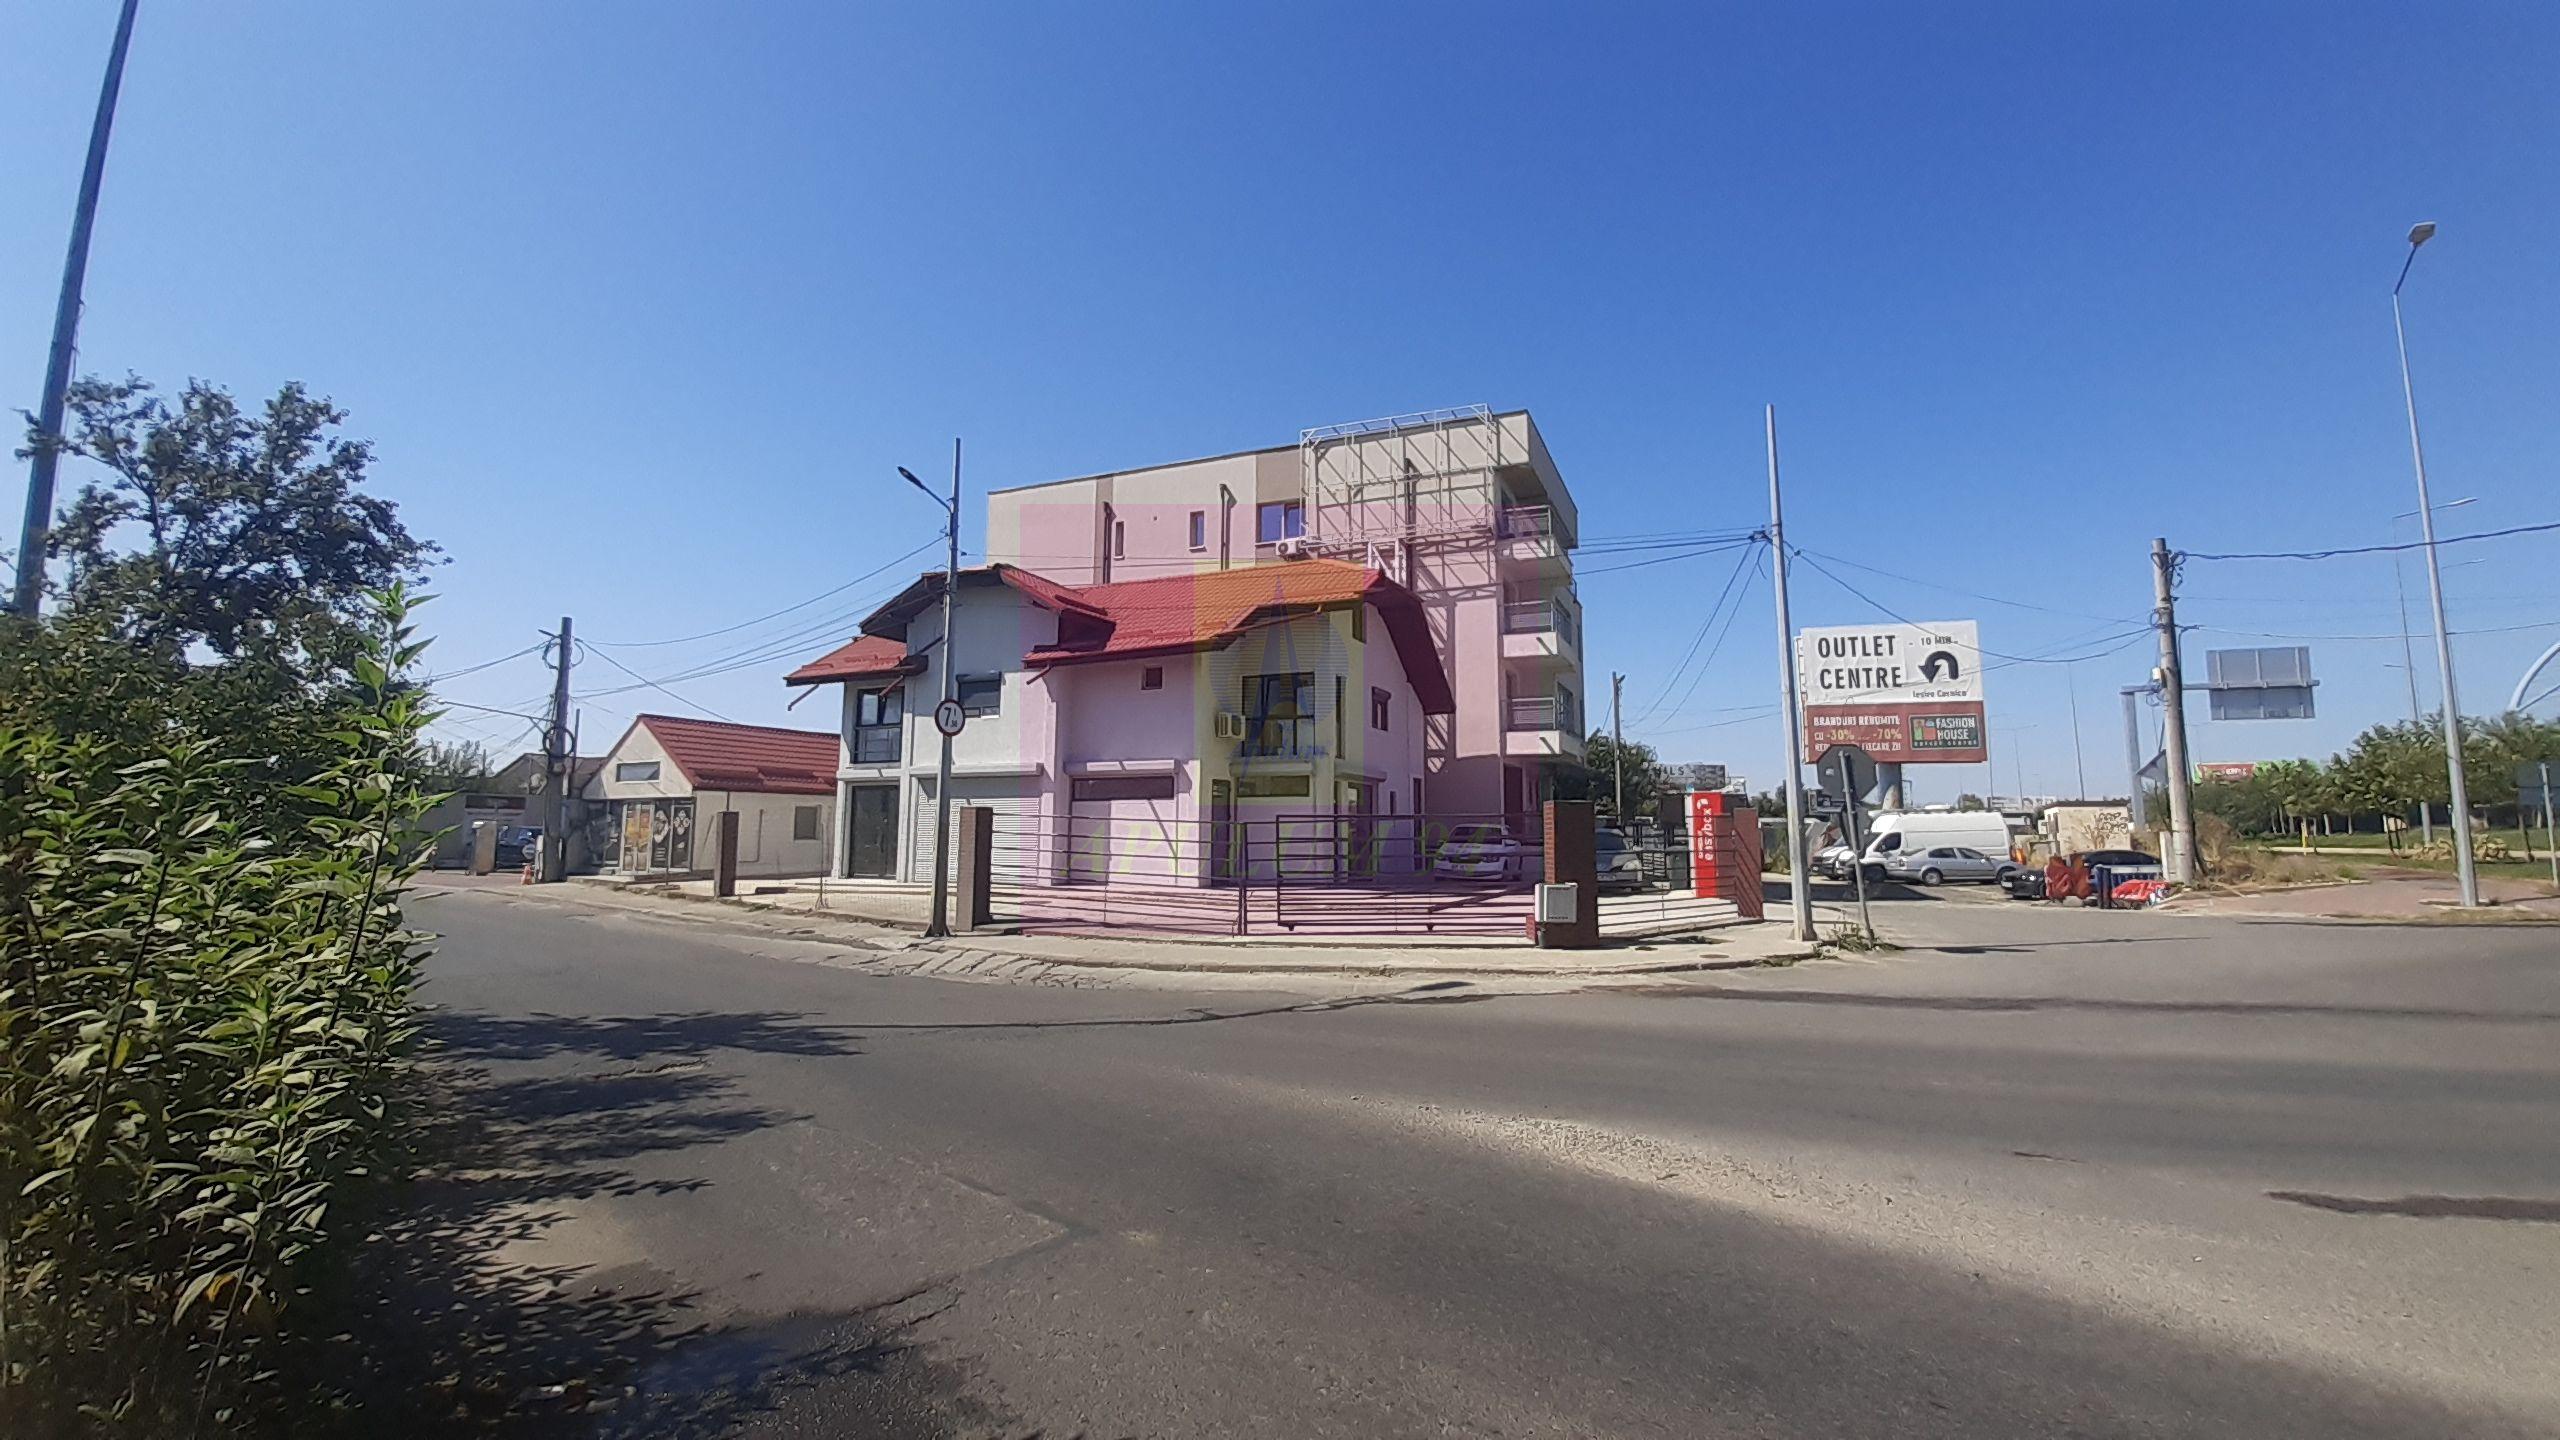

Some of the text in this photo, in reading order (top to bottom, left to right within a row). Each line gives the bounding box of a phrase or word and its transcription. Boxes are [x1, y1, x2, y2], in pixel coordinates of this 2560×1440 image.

[1818, 635, 1896, 658] OUTLET
[1920, 637, 1932, 646] 10
[1820, 667, 1902, 689] CENTRE
[1935, 717, 1976, 729] FASHION
[1936, 729, 1970, 740] HOUSE
